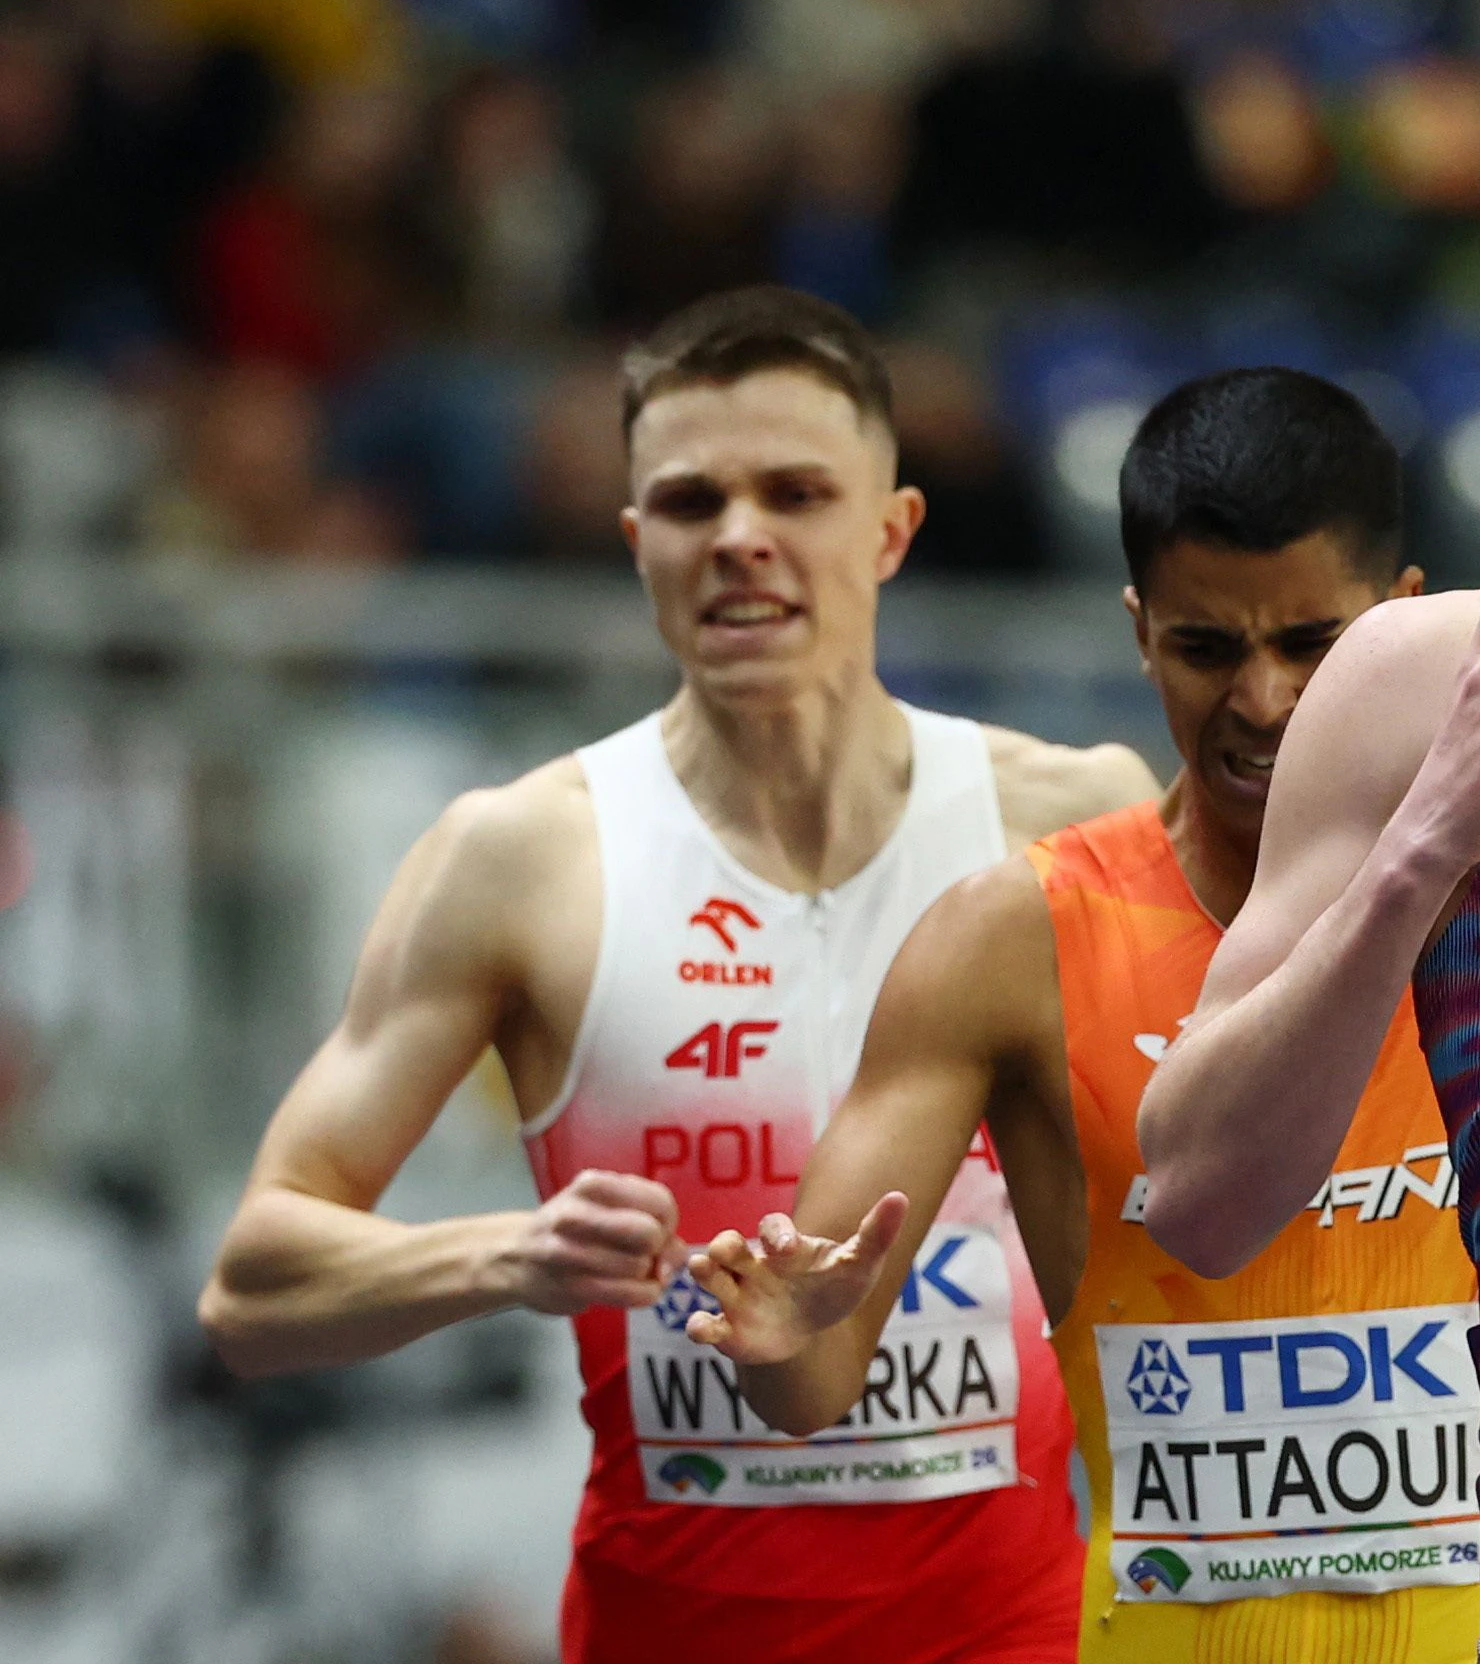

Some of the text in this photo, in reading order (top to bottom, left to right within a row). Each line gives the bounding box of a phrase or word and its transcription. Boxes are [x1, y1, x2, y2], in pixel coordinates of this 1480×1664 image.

[678, 961, 773, 987] ORLEN
[664, 1020, 780, 1079] 4F
[644, 1118, 1001, 1187] POLA
[646, 1334, 998, 1432] WYRKA
[1187, 1320, 1459, 1413] TDK
[744, 1463, 843, 1487] KUJAWY
[1132, 1423, 1468, 1521] ATTAOUI
[1208, 1542, 1479, 1583] KUJAWY POMORZE 26
